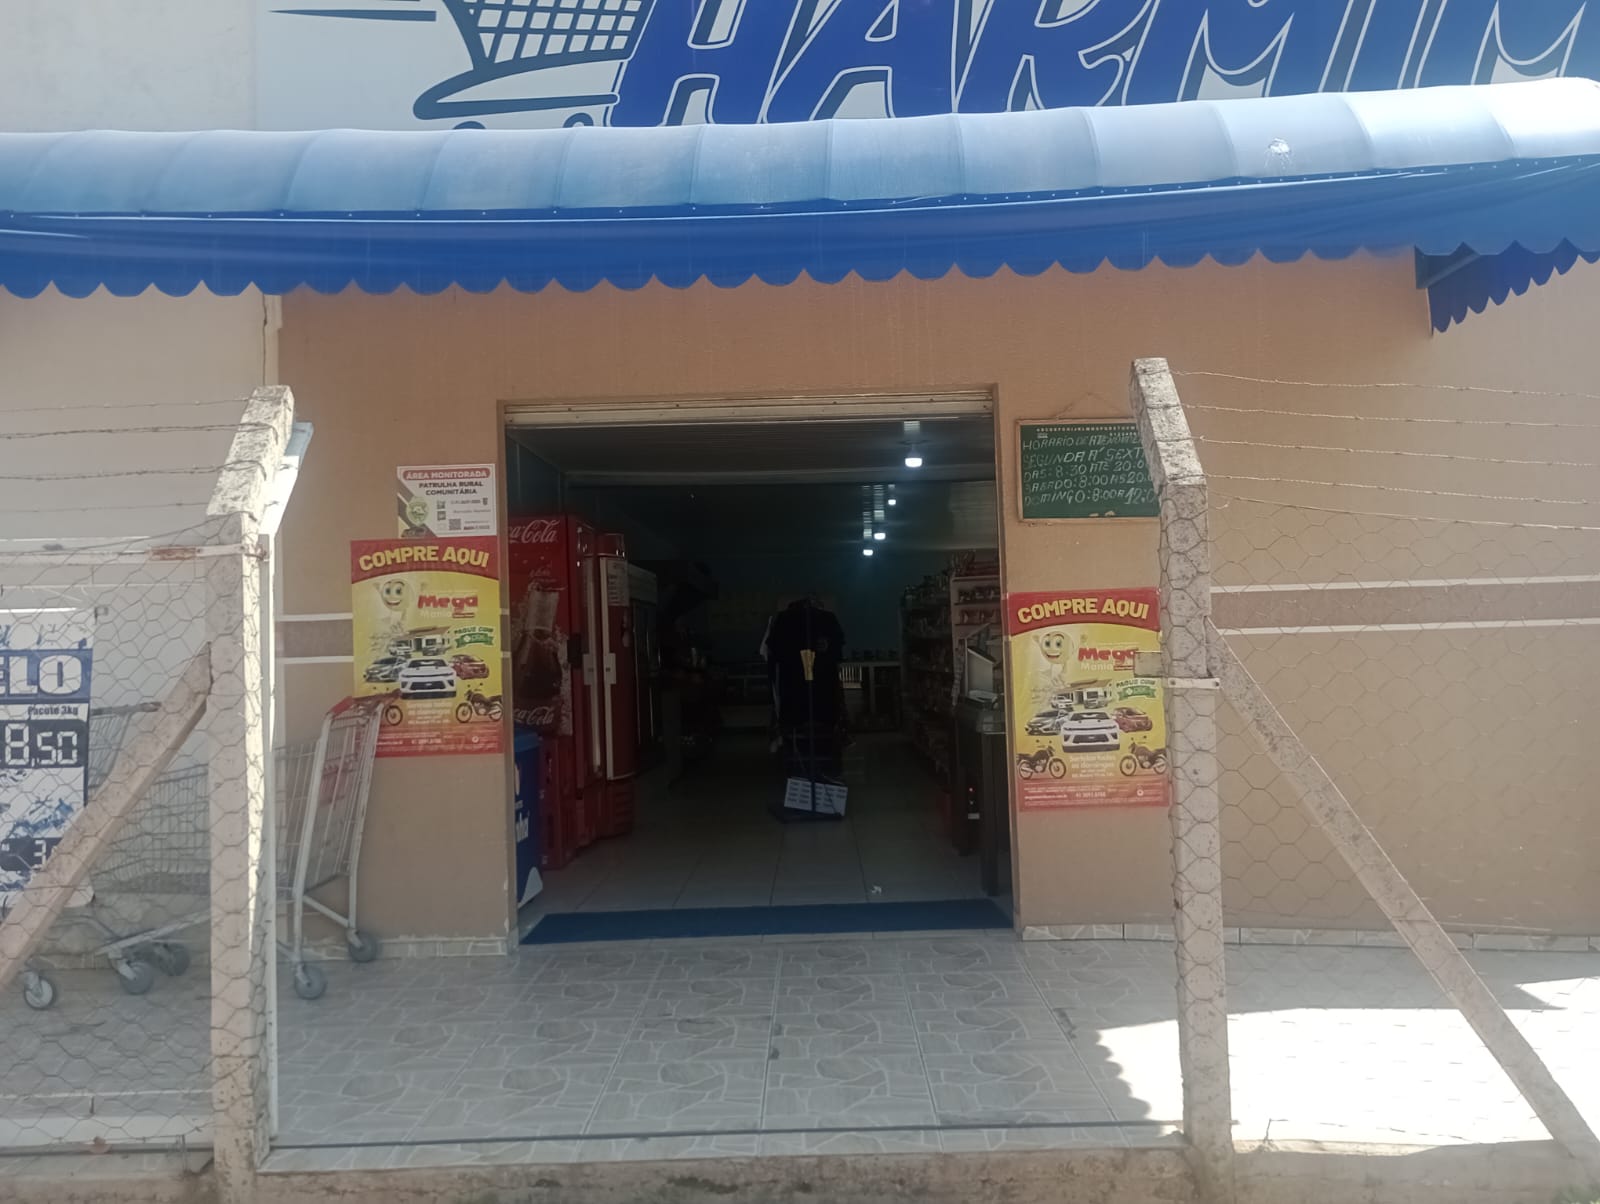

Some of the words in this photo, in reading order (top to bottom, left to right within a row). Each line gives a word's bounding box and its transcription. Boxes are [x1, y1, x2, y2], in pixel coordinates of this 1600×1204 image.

[1023, 451, 1086, 468] SEGUNDA
[1103, 446, 1146, 462] SEXT
[406, 471, 430, 480] ÁREA
[431, 470, 487, 479] MONITORADA
[425, 488, 478, 496] COMUNITÁRIA
[358, 545, 440, 571] COMPRE
[442, 546, 490, 569] AQUI
[417, 595, 479, 613] Mega
[1017, 597, 1099, 624] COMPRE
[1101, 597, 1150, 620] AQUI
[1077, 647, 1138, 665] Mega
[27, 706, 61, 716] Pacote
[61, 705, 79, 716] 3kg
